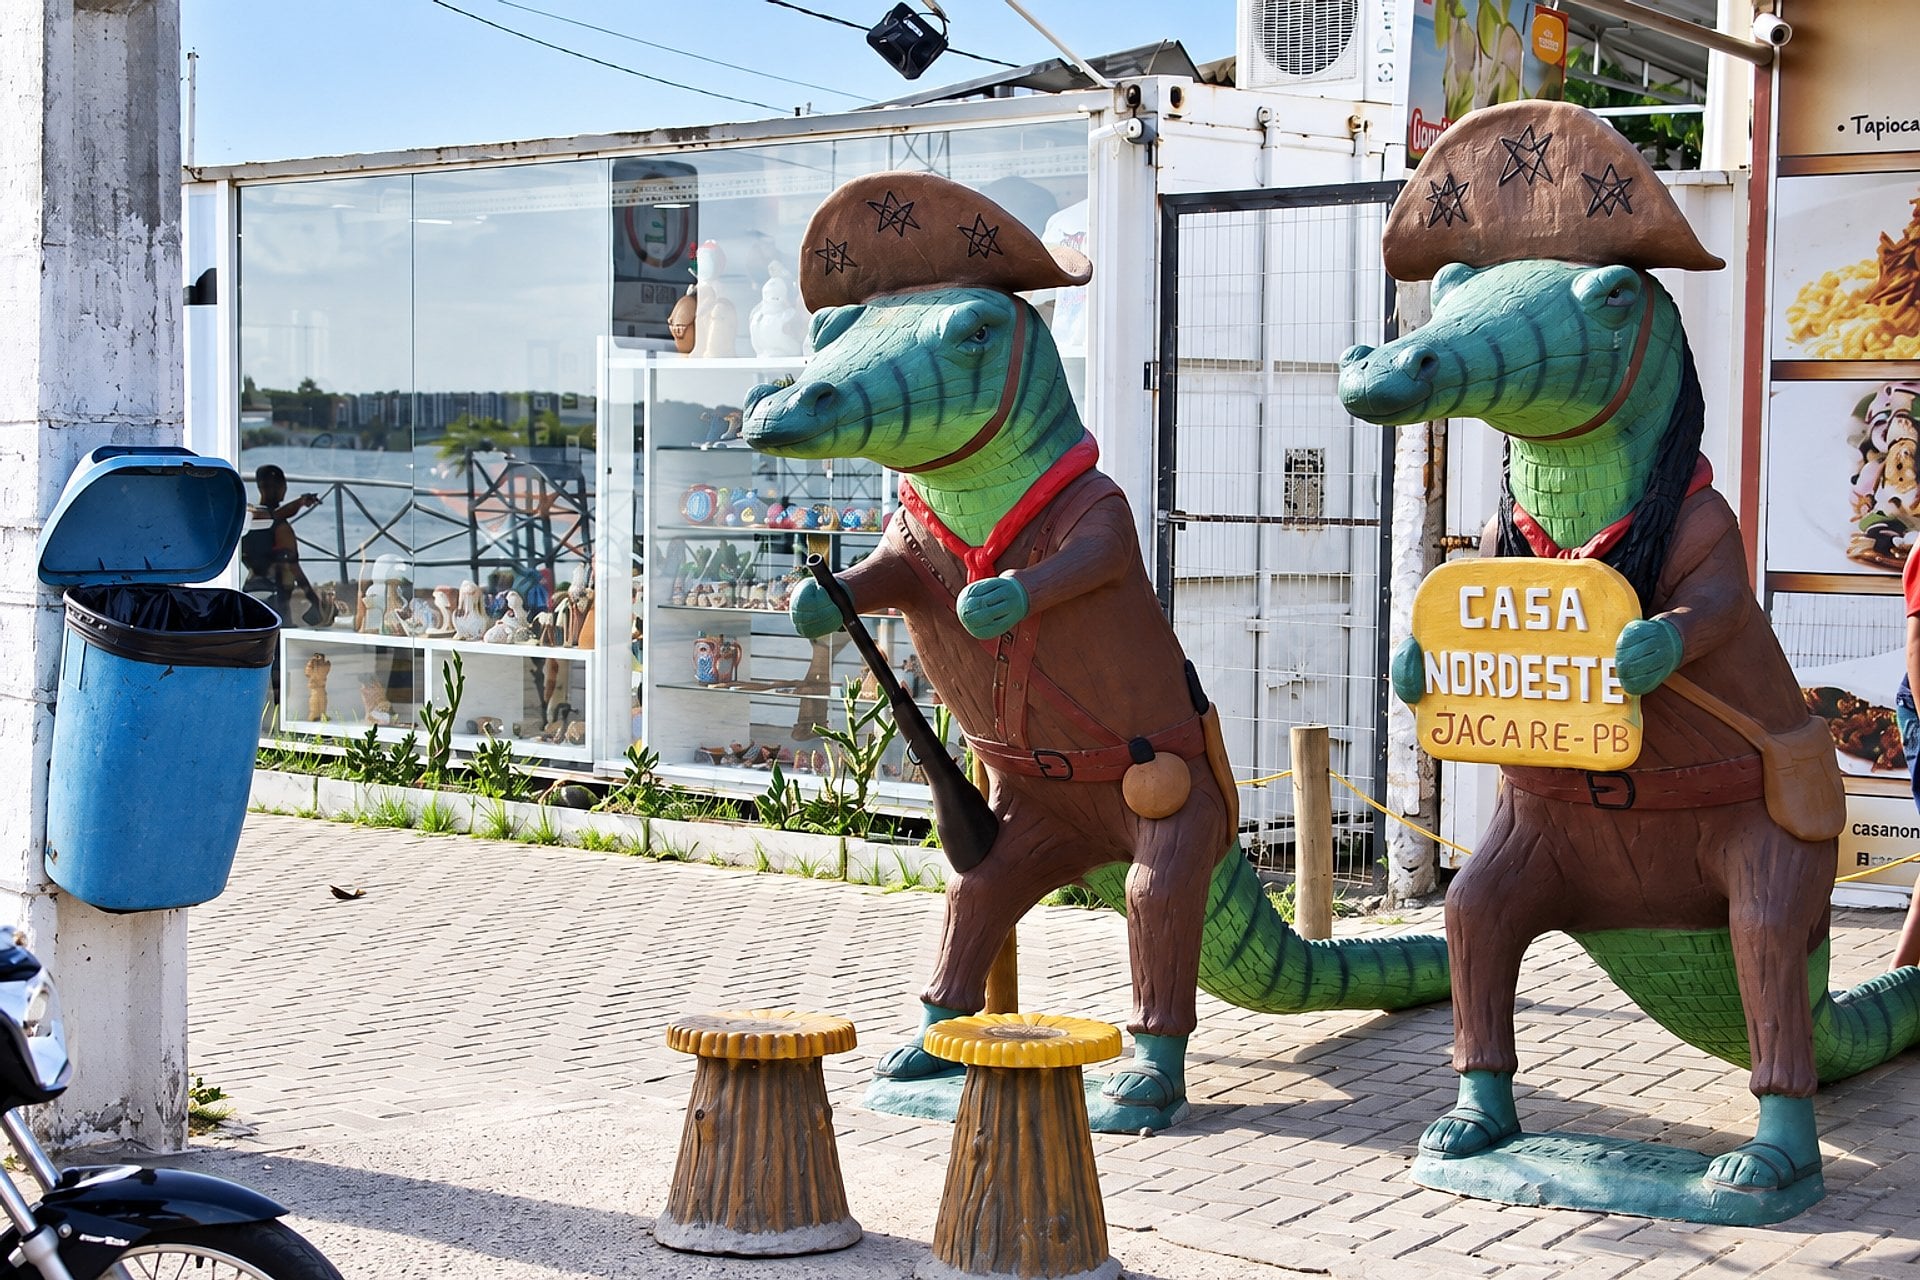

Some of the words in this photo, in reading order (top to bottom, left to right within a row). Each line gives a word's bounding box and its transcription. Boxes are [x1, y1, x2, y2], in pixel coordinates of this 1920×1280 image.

[1850, 114, 1920, 141] Tapioca
[1459, 586, 1589, 632] CASA
[1424, 650, 1626, 705] NORDESTE
[1431, 712, 1630, 754] JACARE-PB
[1852, 823, 1920, 839] casanon
